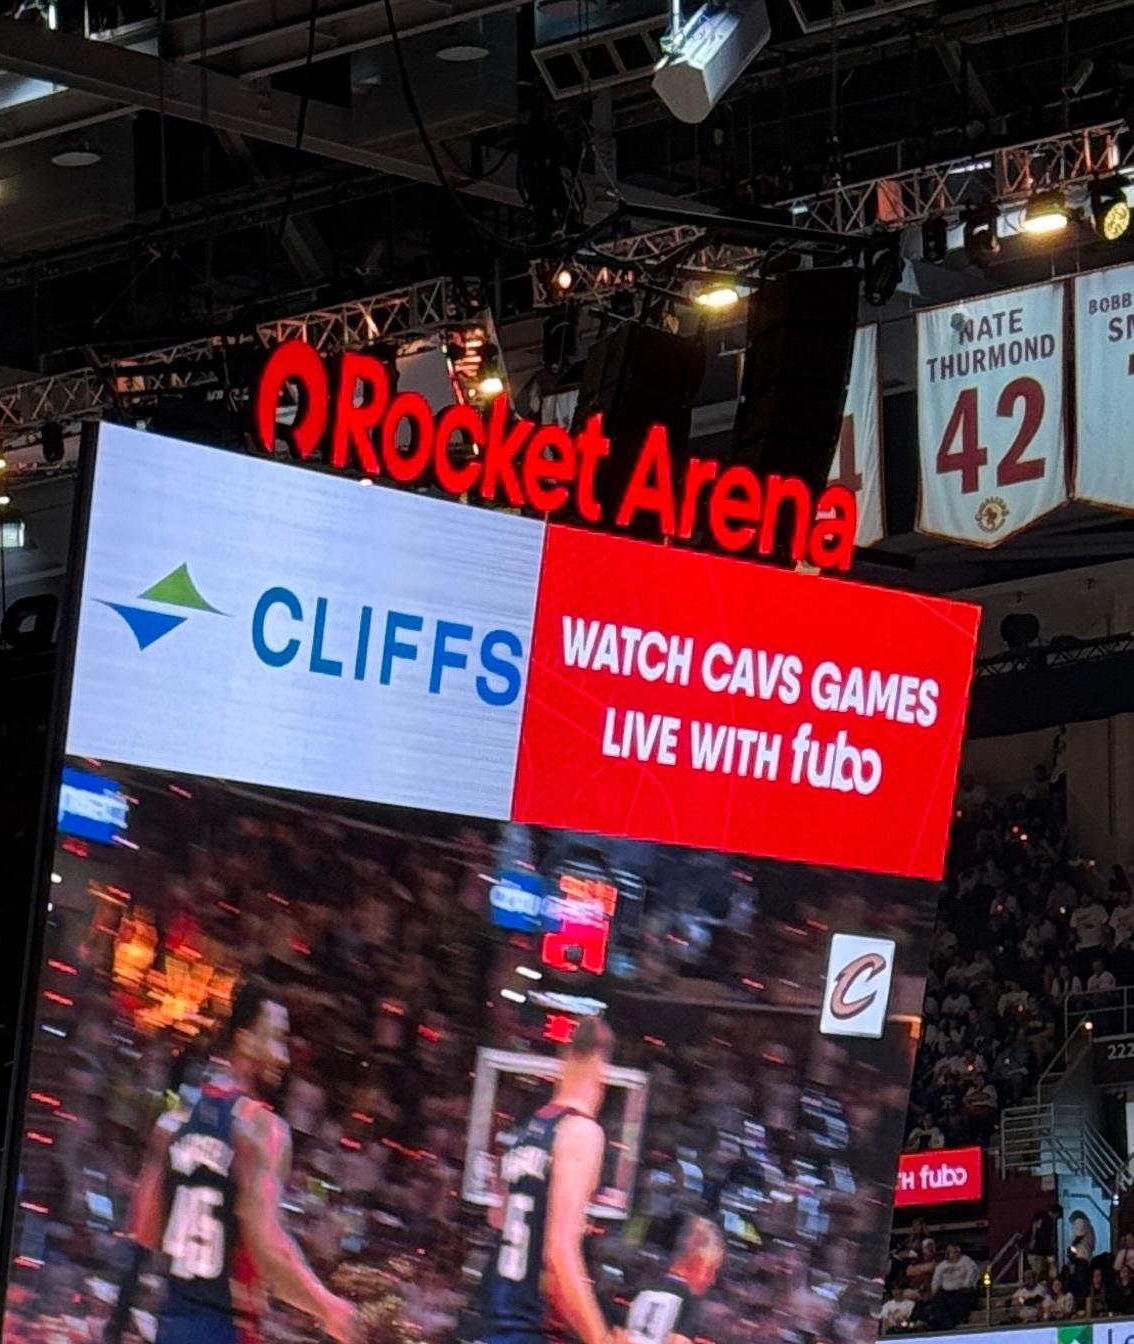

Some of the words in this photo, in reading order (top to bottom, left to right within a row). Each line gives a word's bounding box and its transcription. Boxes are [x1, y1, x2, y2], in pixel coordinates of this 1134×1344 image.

[958, 308, 1023, 345] NATE
[1088, 293, 1134, 315] BOBB
[926, 334, 1056, 383] THURMOND
[332, 351, 612, 520] Rocket
[619, 425, 856, 571] Arena
[936, 376, 1046, 494] 42
[252, 586, 524, 707] CLIFFS
[562, 616, 691, 687] WATCH
[701, 641, 801, 704] CAVS
[811, 660, 939, 728] GAMES
[603, 707, 678, 766] LIVE
[690, 722, 779, 781] WITH
[791, 731, 882, 796] fubo
[919, 1164, 968, 1190] fubo
